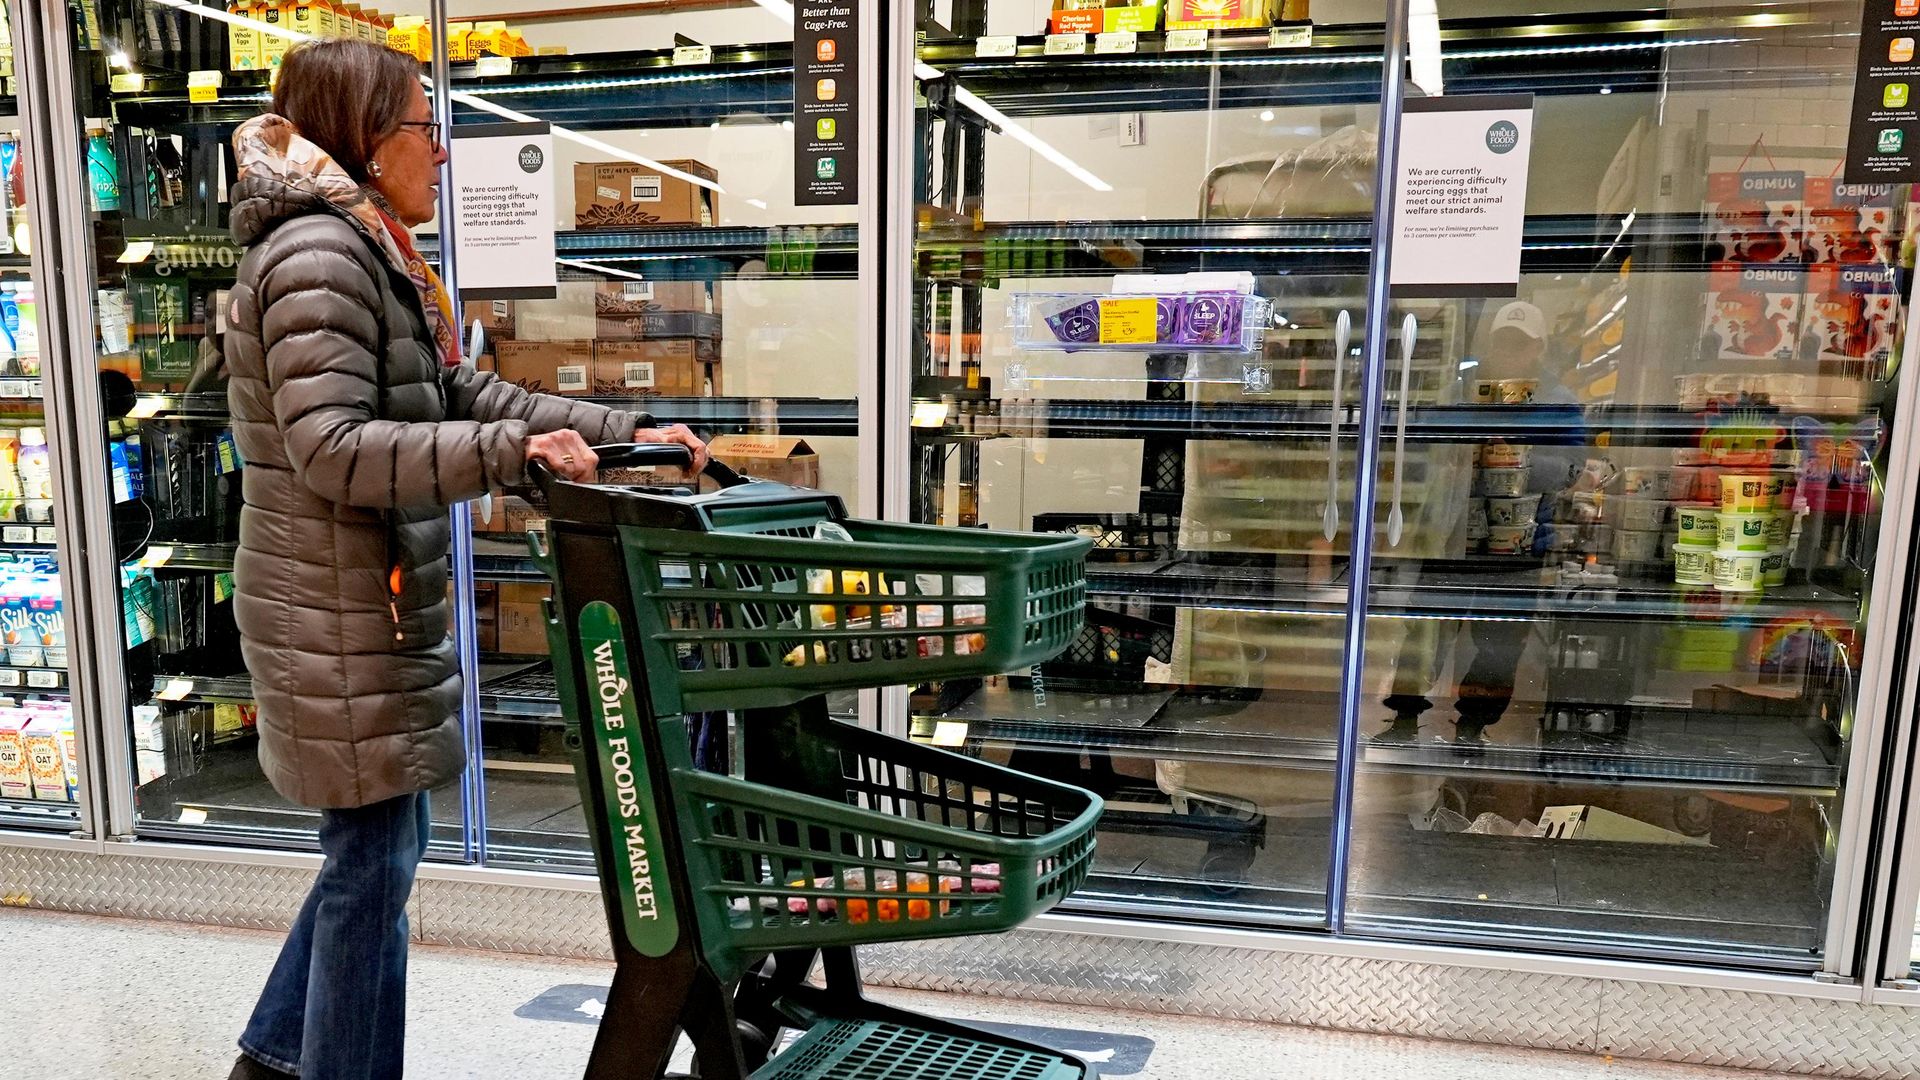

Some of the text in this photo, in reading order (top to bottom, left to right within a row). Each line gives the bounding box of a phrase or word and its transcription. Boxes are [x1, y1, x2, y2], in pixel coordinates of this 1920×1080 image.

[267, 10, 278, 18] 365
[802, 6, 850, 17] Better than
[804, 20, 848, 31] Cage-Free.
[388, 34, 410, 43] Eggs
[448, 40, 459, 48] gs
[469, 39, 491, 48] Eggs
[1490, 128, 1516, 137] WHOLE
[520, 150, 541, 159] WHOLE
[1441, 167, 1481, 176] currently
[1407, 176, 1507, 187] experiencing difficulty
[1407, 187, 1444, 196] sourcing
[1473, 196, 1502, 204] animal
[1070, 324, 1090, 335] SLEEP
[1746, 522, 1760, 530] 365
[1, 606, 38, 634] Silk
[2, 753, 16, 761] OAT
[36, 756, 51, 764] OAT
[593, 640, 658, 921] WHOLE FOODS MARKET
